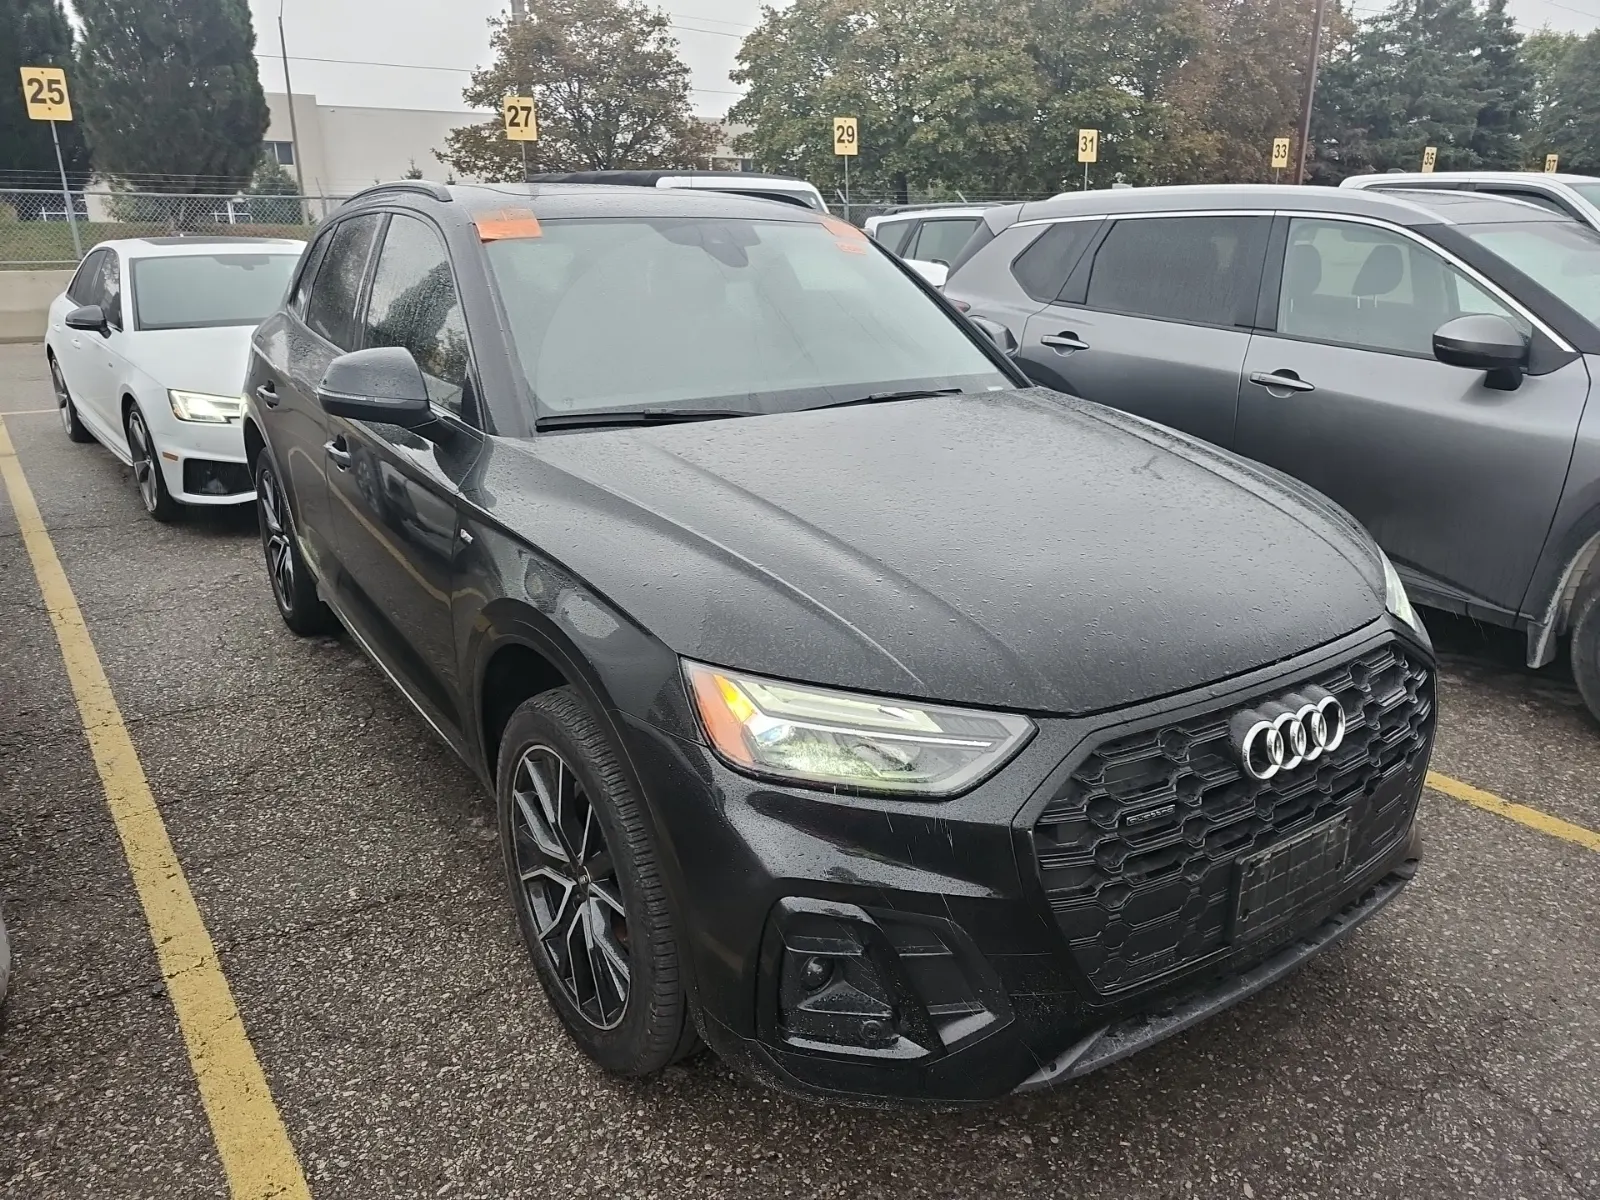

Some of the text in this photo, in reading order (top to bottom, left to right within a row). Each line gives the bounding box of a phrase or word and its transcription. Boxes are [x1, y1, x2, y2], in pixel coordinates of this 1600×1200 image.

[27, 78, 65, 105] 25
[507, 105, 532, 128] 27
[836, 125, 855, 144] 29
[1080, 136, 1095, 153] 31
[1274, 144, 1287, 159] 33
[1424, 152, 1435, 166] 35
[1546, 159, 1557, 172] 37
